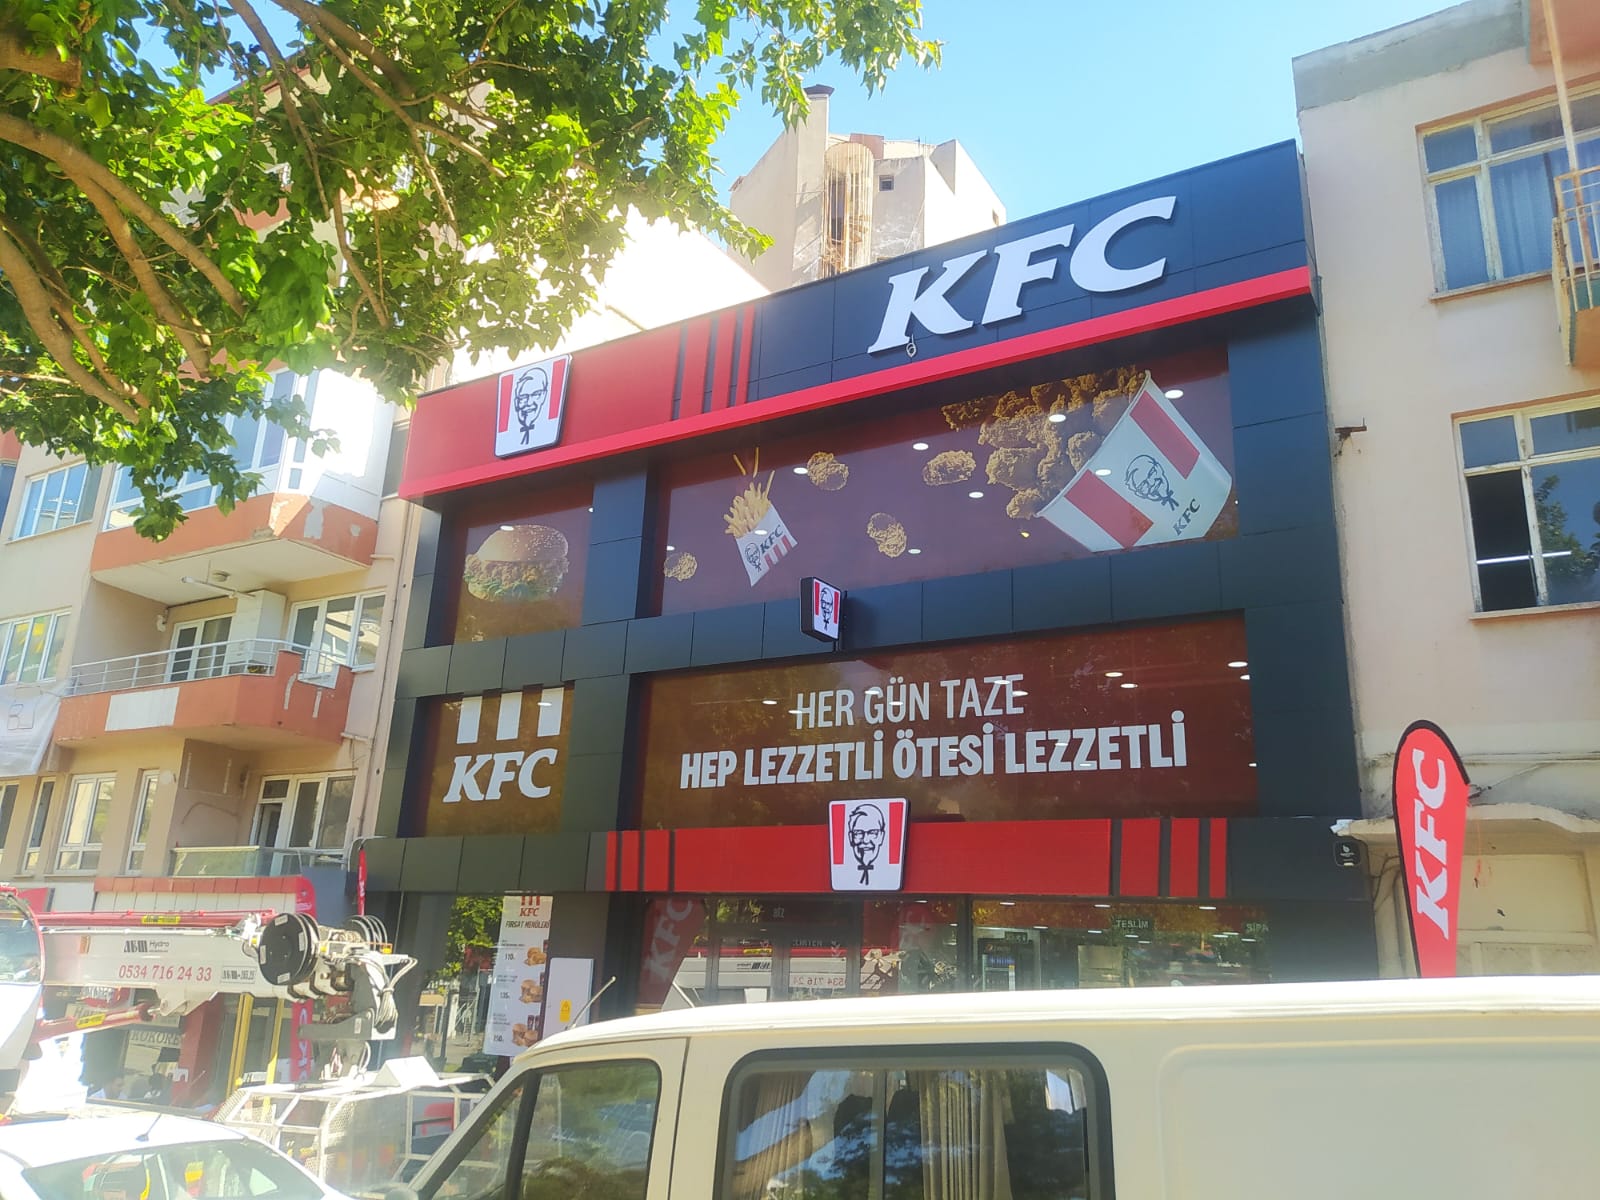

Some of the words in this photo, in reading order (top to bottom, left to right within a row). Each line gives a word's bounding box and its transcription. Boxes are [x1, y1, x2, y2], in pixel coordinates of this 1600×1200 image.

[867, 196, 1177, 355] KFC
[760, 524, 784, 554] KFC
[1172, 498, 1201, 536] KFC
[796, 689, 854, 730] HER
[863, 676, 931, 725] GÜN
[940, 673, 1025, 718] TAZE
[680, 750, 738, 789] HEP
[744, 730, 883, 786] LEZZETLİ
[893, 722, 994, 780] ÖTESİ
[1005, 710, 1187, 774] LEZZETLİ
[443, 748, 558, 803] KFC
[1411, 748, 1449, 940] KFC
[519, 907, 540, 917] KFC
[1115, 918, 1149, 929] TESLİM
[644, 899, 693, 982] KFC
[118, 964, 148, 979] 0534
[152, 965, 174, 980] 716
[177, 966, 193, 980] 24
[196, 967, 212, 981] 33
[130, 1030, 181, 1048] KOKORE
